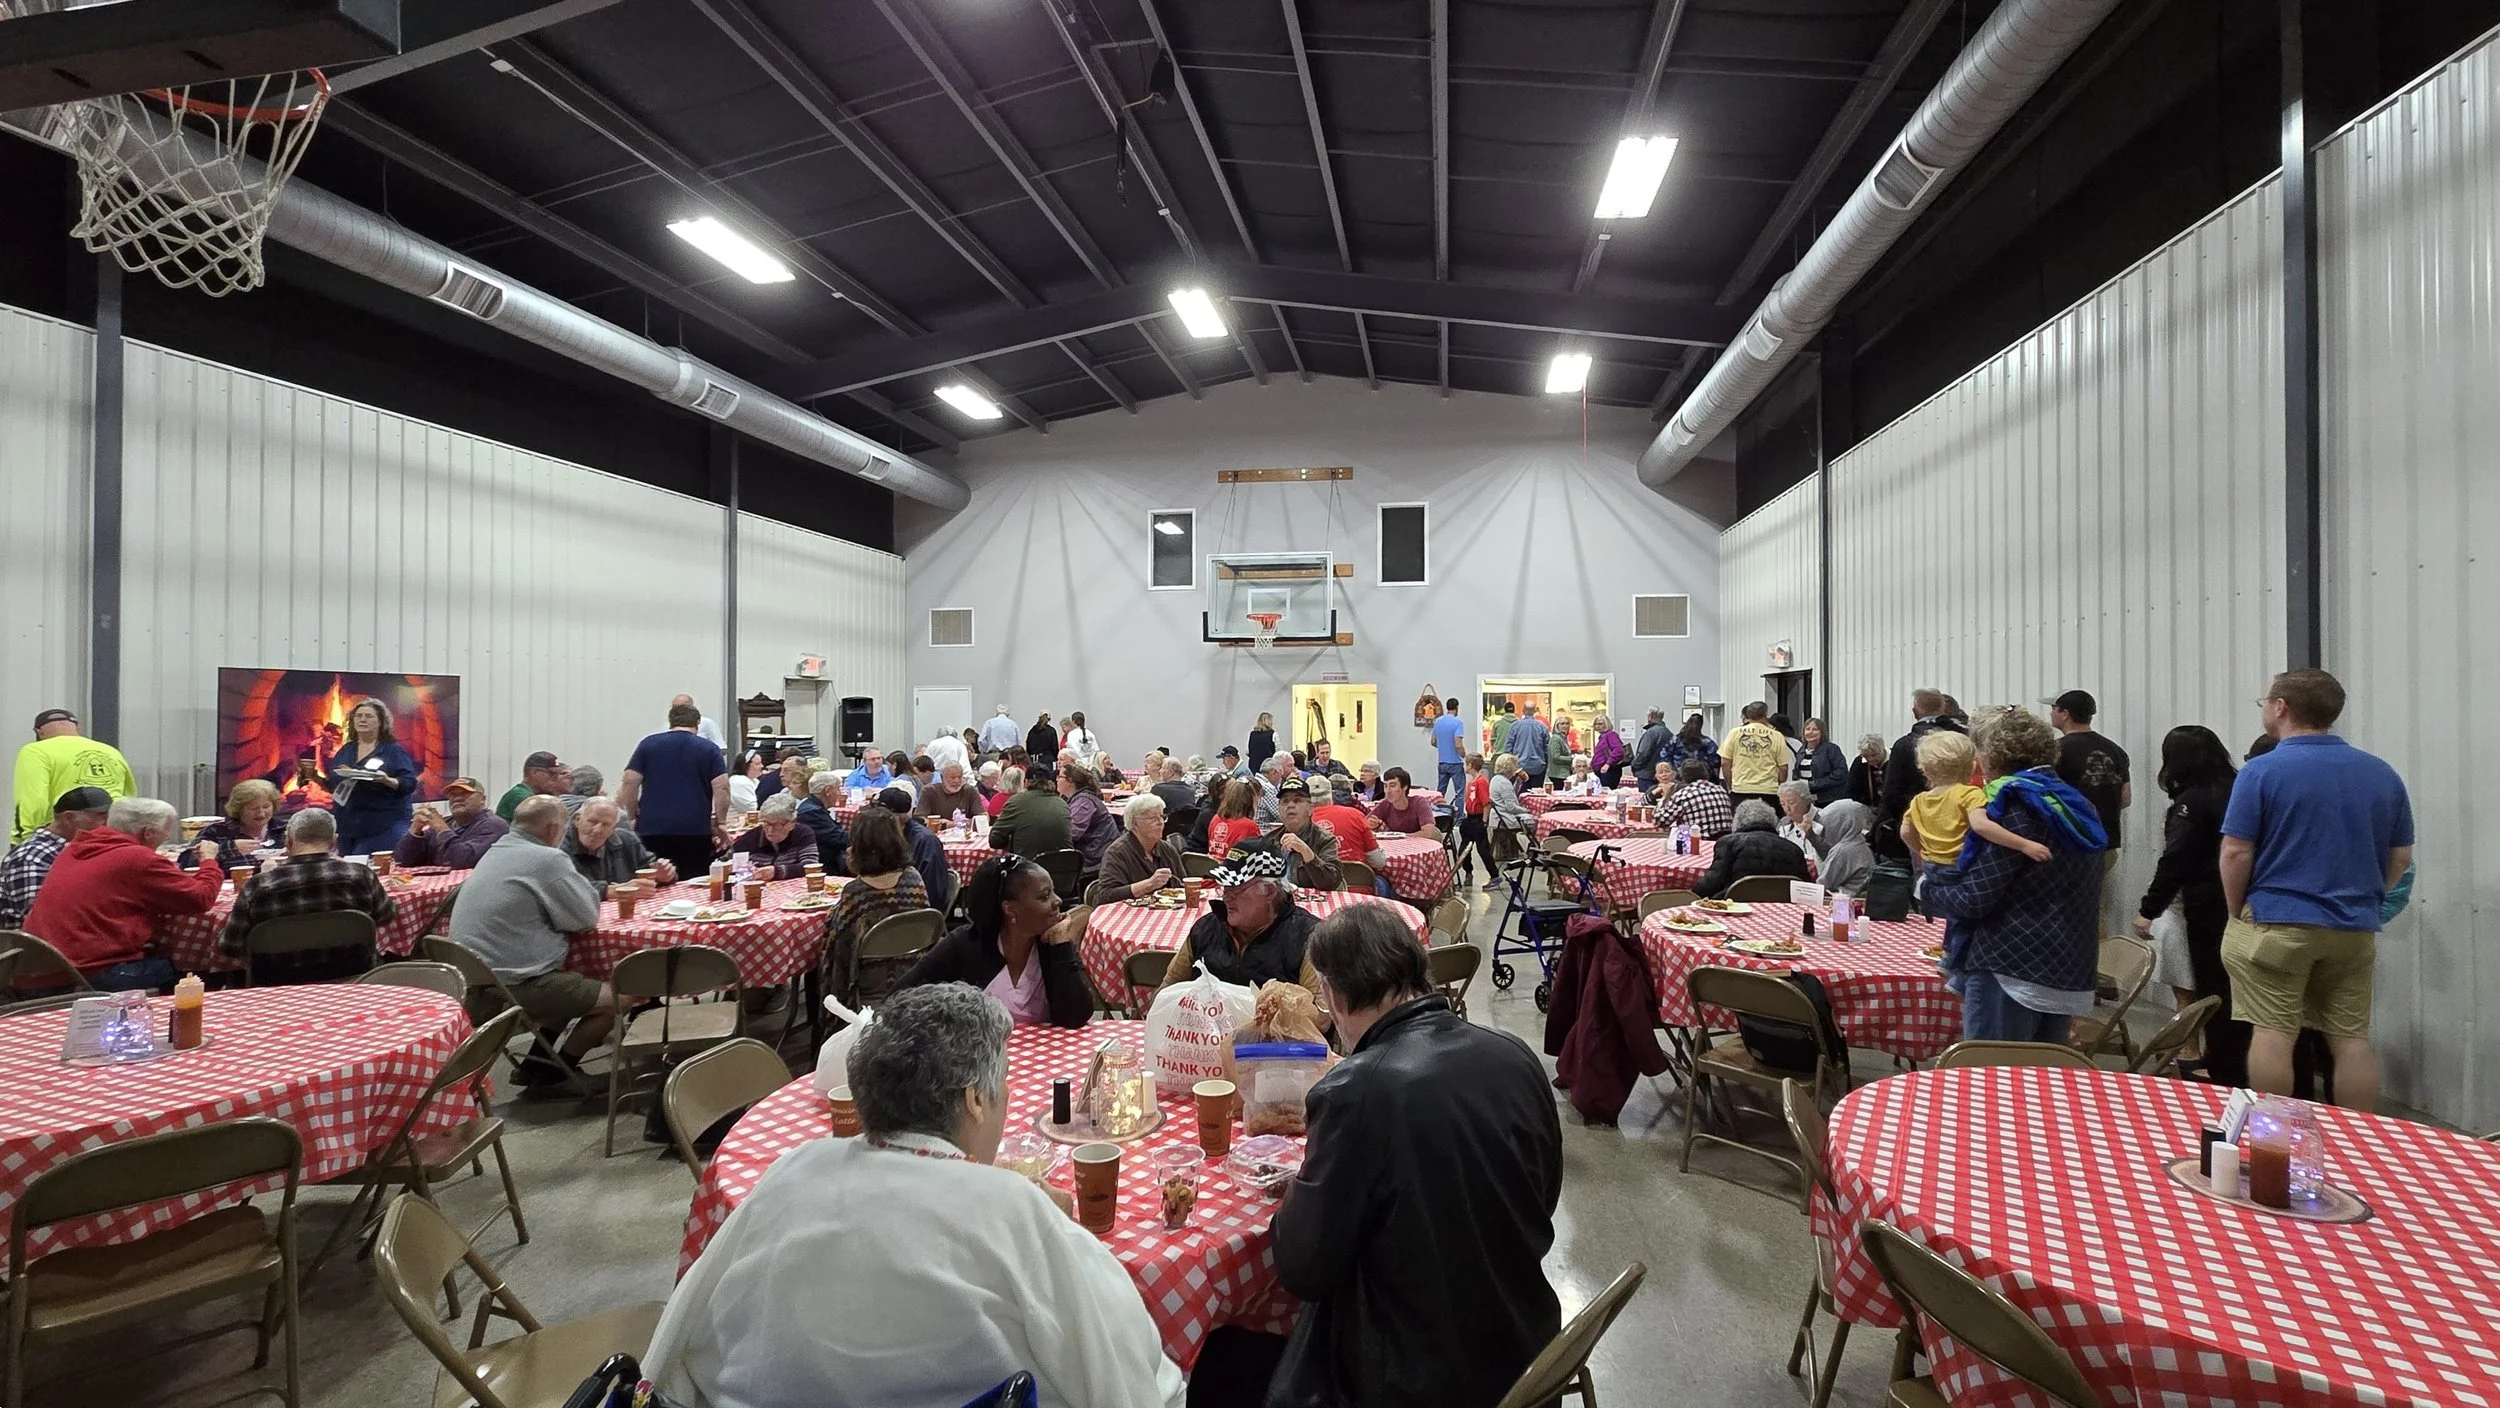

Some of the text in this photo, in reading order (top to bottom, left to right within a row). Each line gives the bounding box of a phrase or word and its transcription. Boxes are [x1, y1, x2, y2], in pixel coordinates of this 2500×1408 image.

[1201, 1002, 1224, 1018] YOU
[1164, 1025, 1200, 1045] THANK
[1168, 1043, 1215, 1063] THANK
[1156, 1055, 1199, 1076] THANK
[1202, 1066, 1223, 1078] YO
